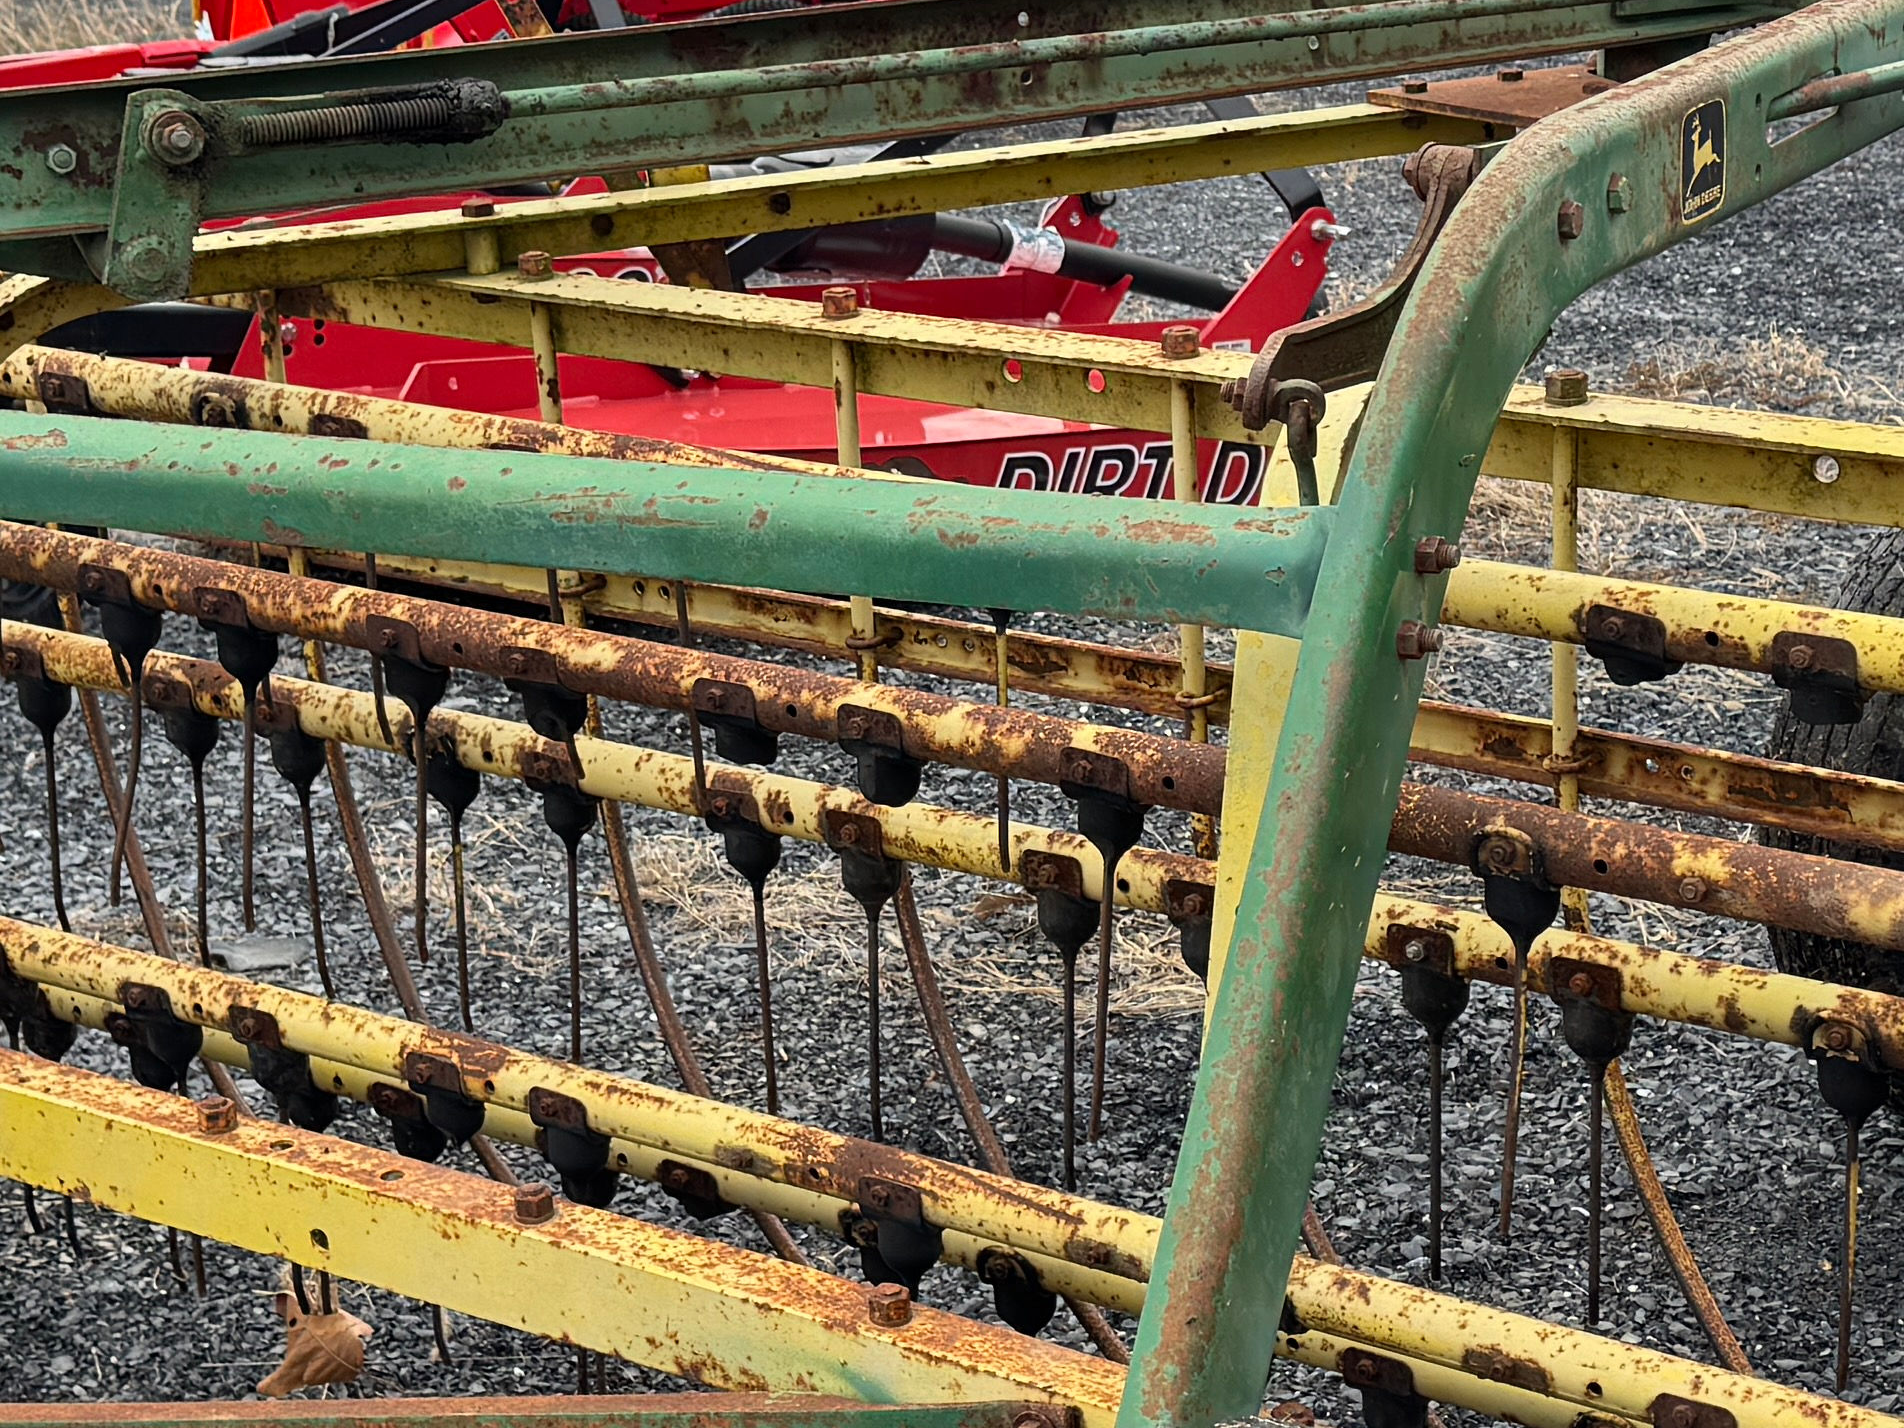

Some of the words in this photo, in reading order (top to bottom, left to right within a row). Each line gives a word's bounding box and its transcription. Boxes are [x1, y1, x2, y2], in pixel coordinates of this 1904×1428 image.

[1684, 196, 1702, 214] JOHN
[1701, 185, 1722, 204] DEERE
[995, 441, 1174, 499] DIRT
